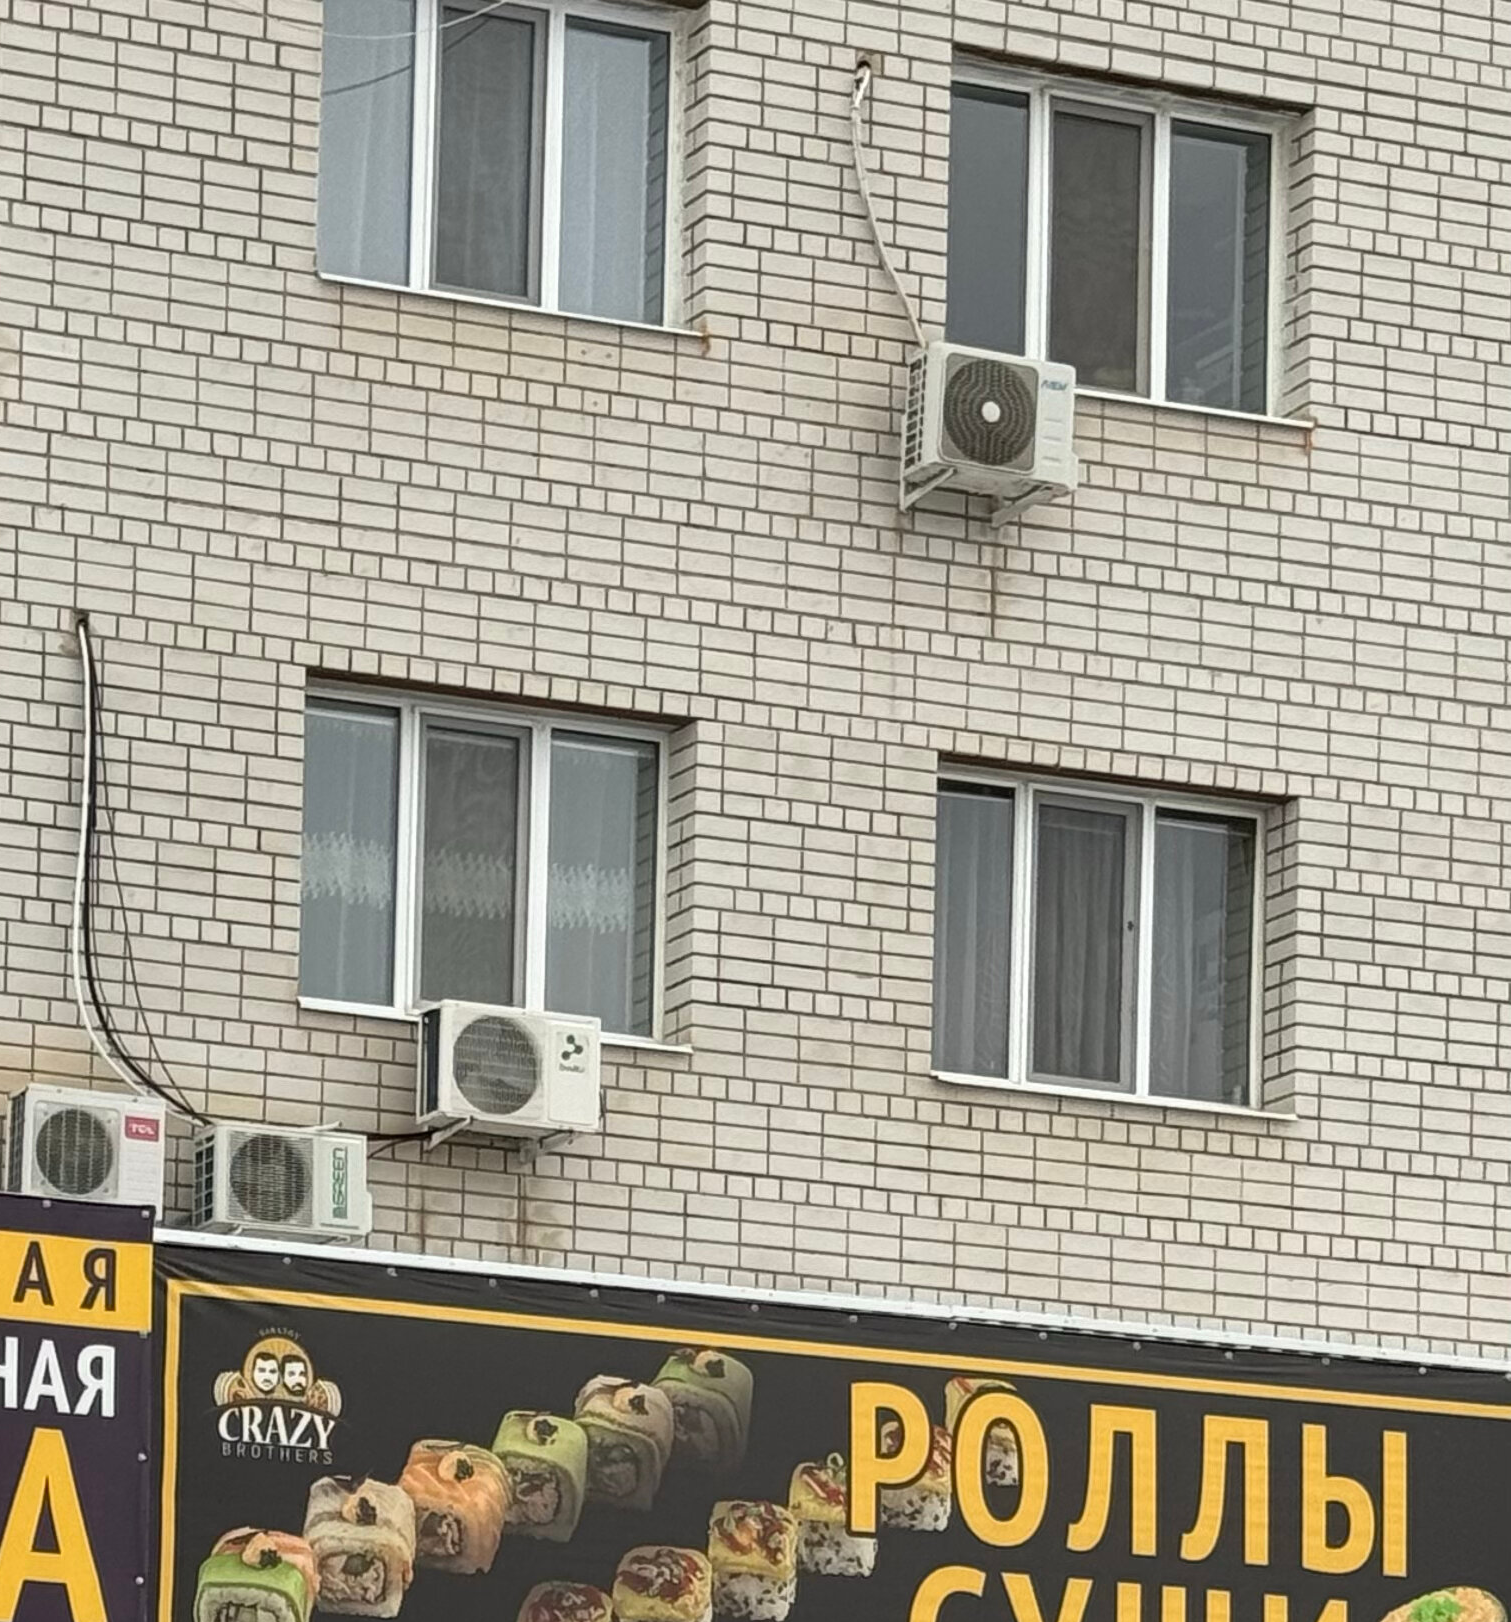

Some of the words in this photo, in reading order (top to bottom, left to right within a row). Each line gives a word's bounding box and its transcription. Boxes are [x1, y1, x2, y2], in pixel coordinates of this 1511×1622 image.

[129, 1122, 157, 1137] TCL
[218, 1406, 336, 1449] CRAZY
[221, 1442, 334, 1466] BROTHERS
[850, 1382, 1408, 1578] РОЛЛЫ
